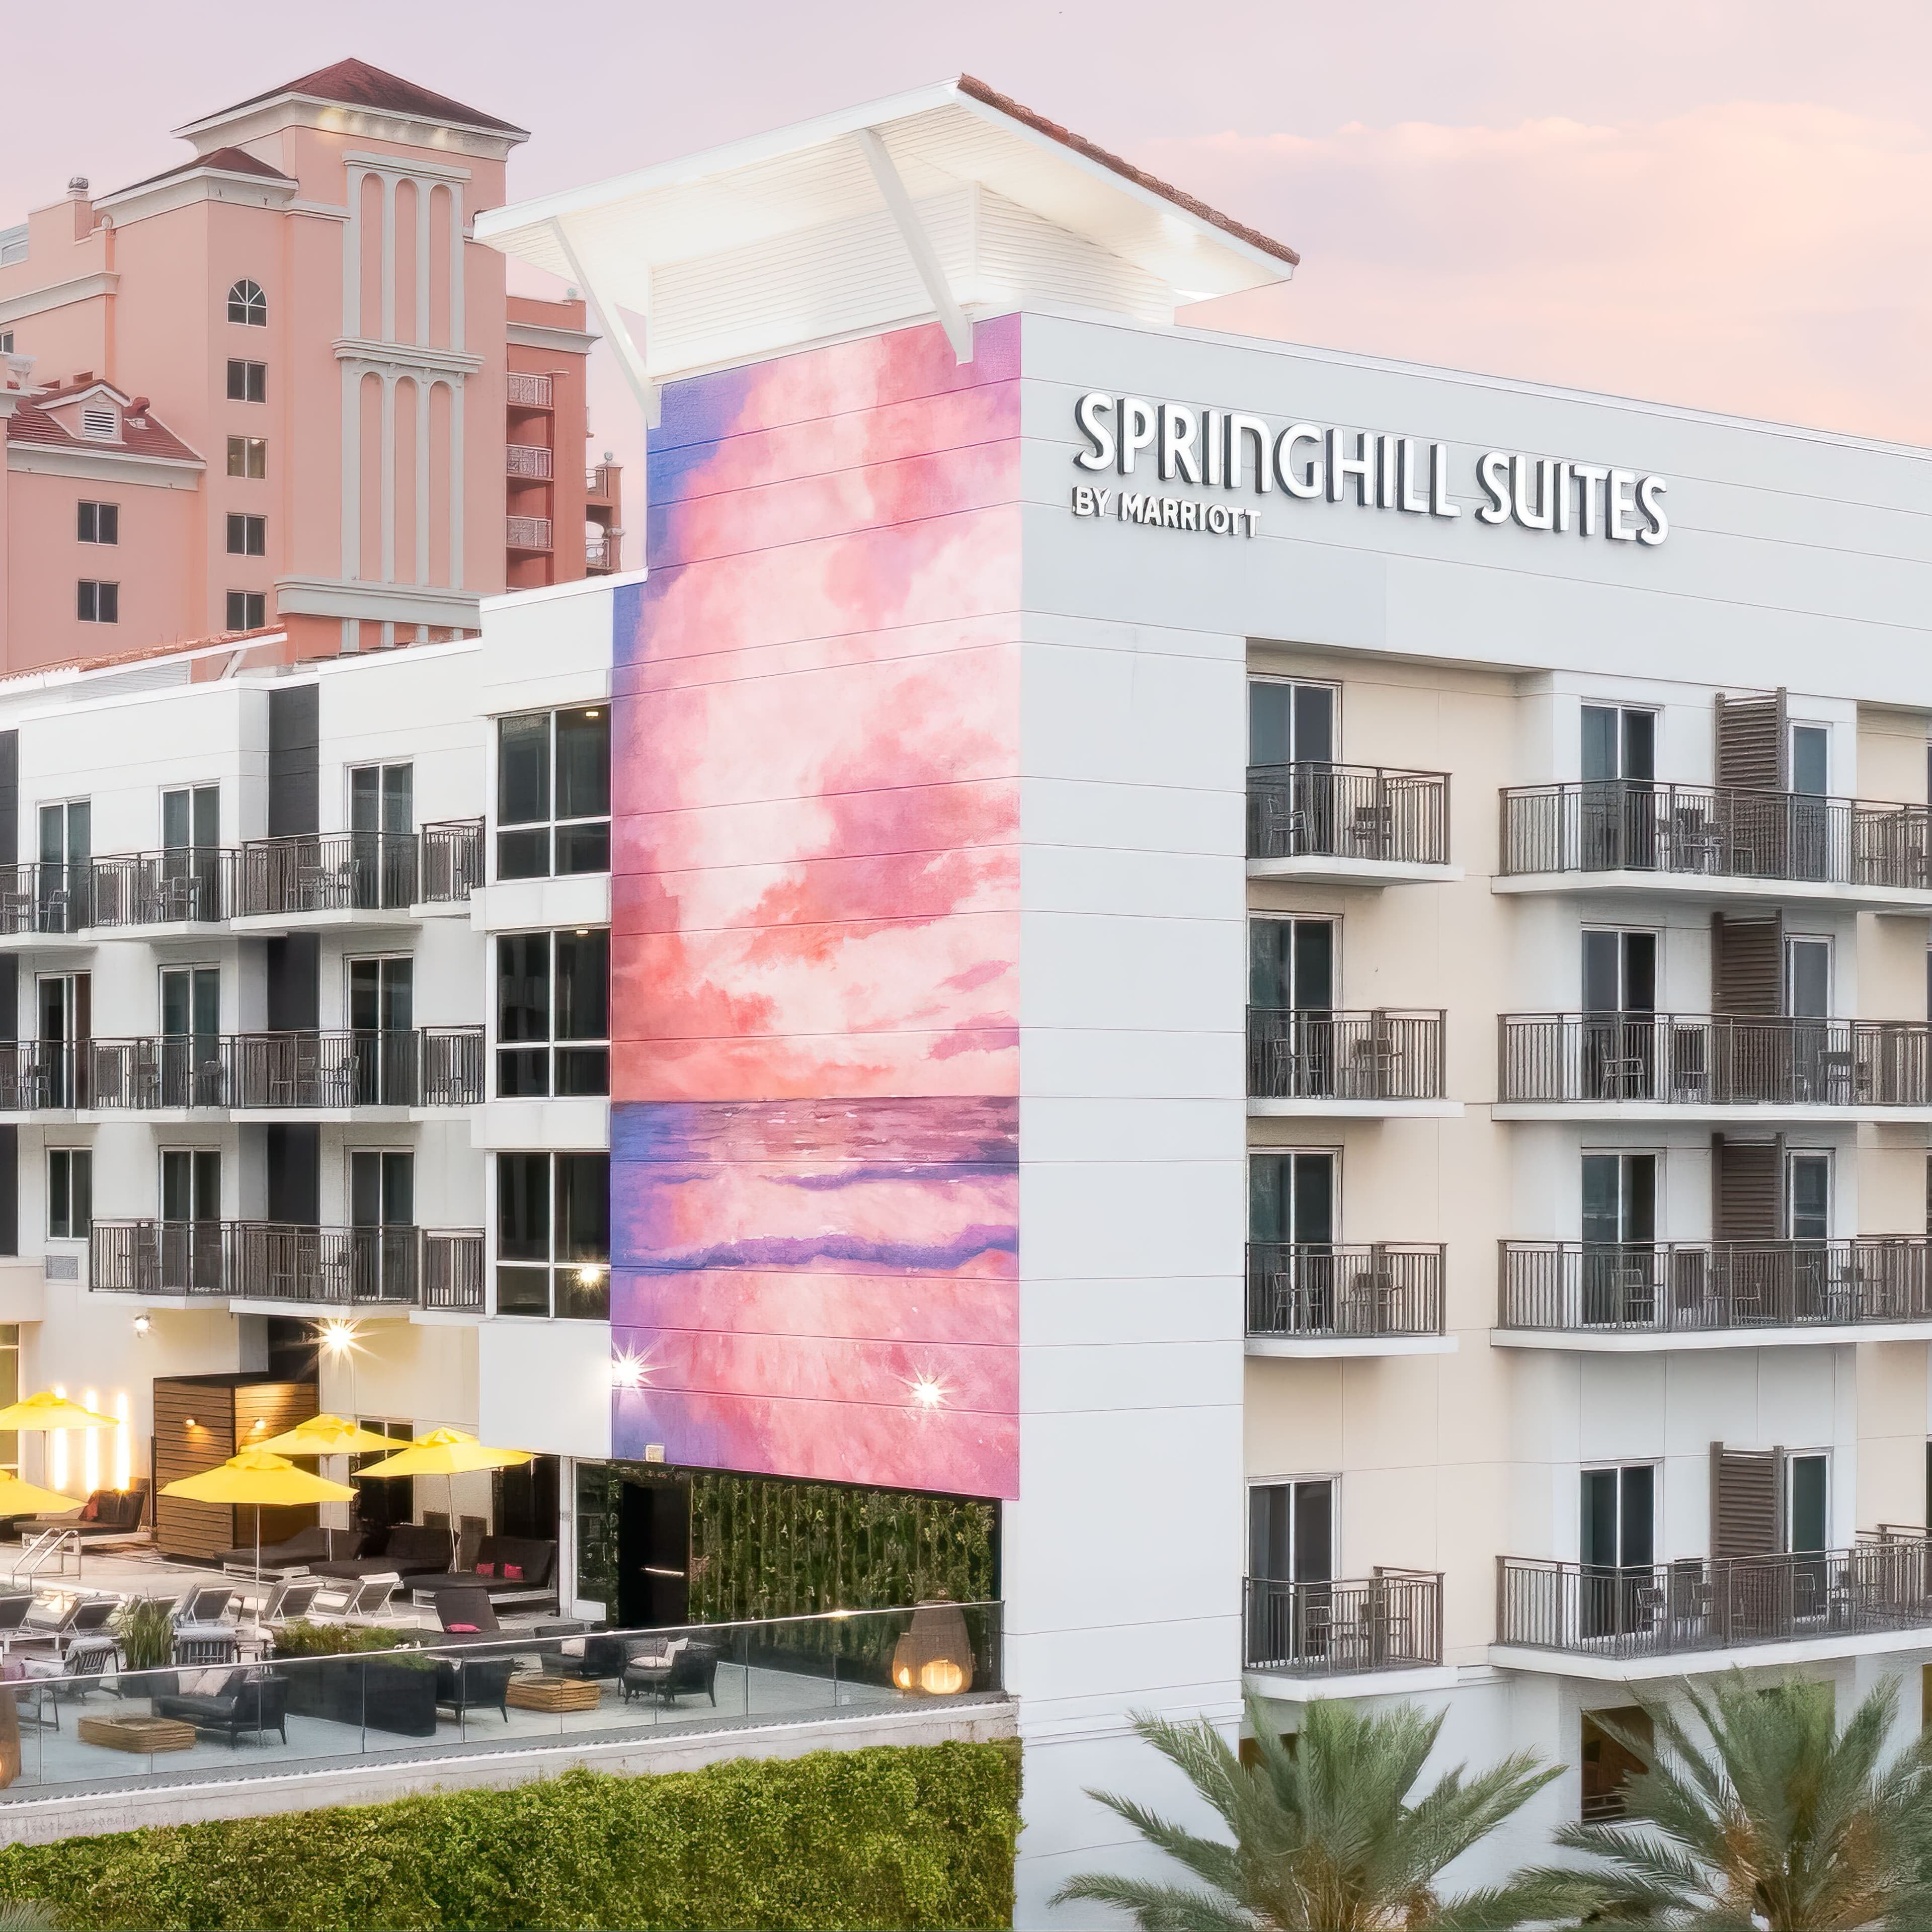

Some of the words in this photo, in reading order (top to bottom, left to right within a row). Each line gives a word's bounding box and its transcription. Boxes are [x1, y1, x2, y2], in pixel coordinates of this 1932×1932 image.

[1073, 487, 1111, 517] BY
[1118, 493, 1262, 538] MARRIOTT
[1475, 451, 1669, 546] SUITES
